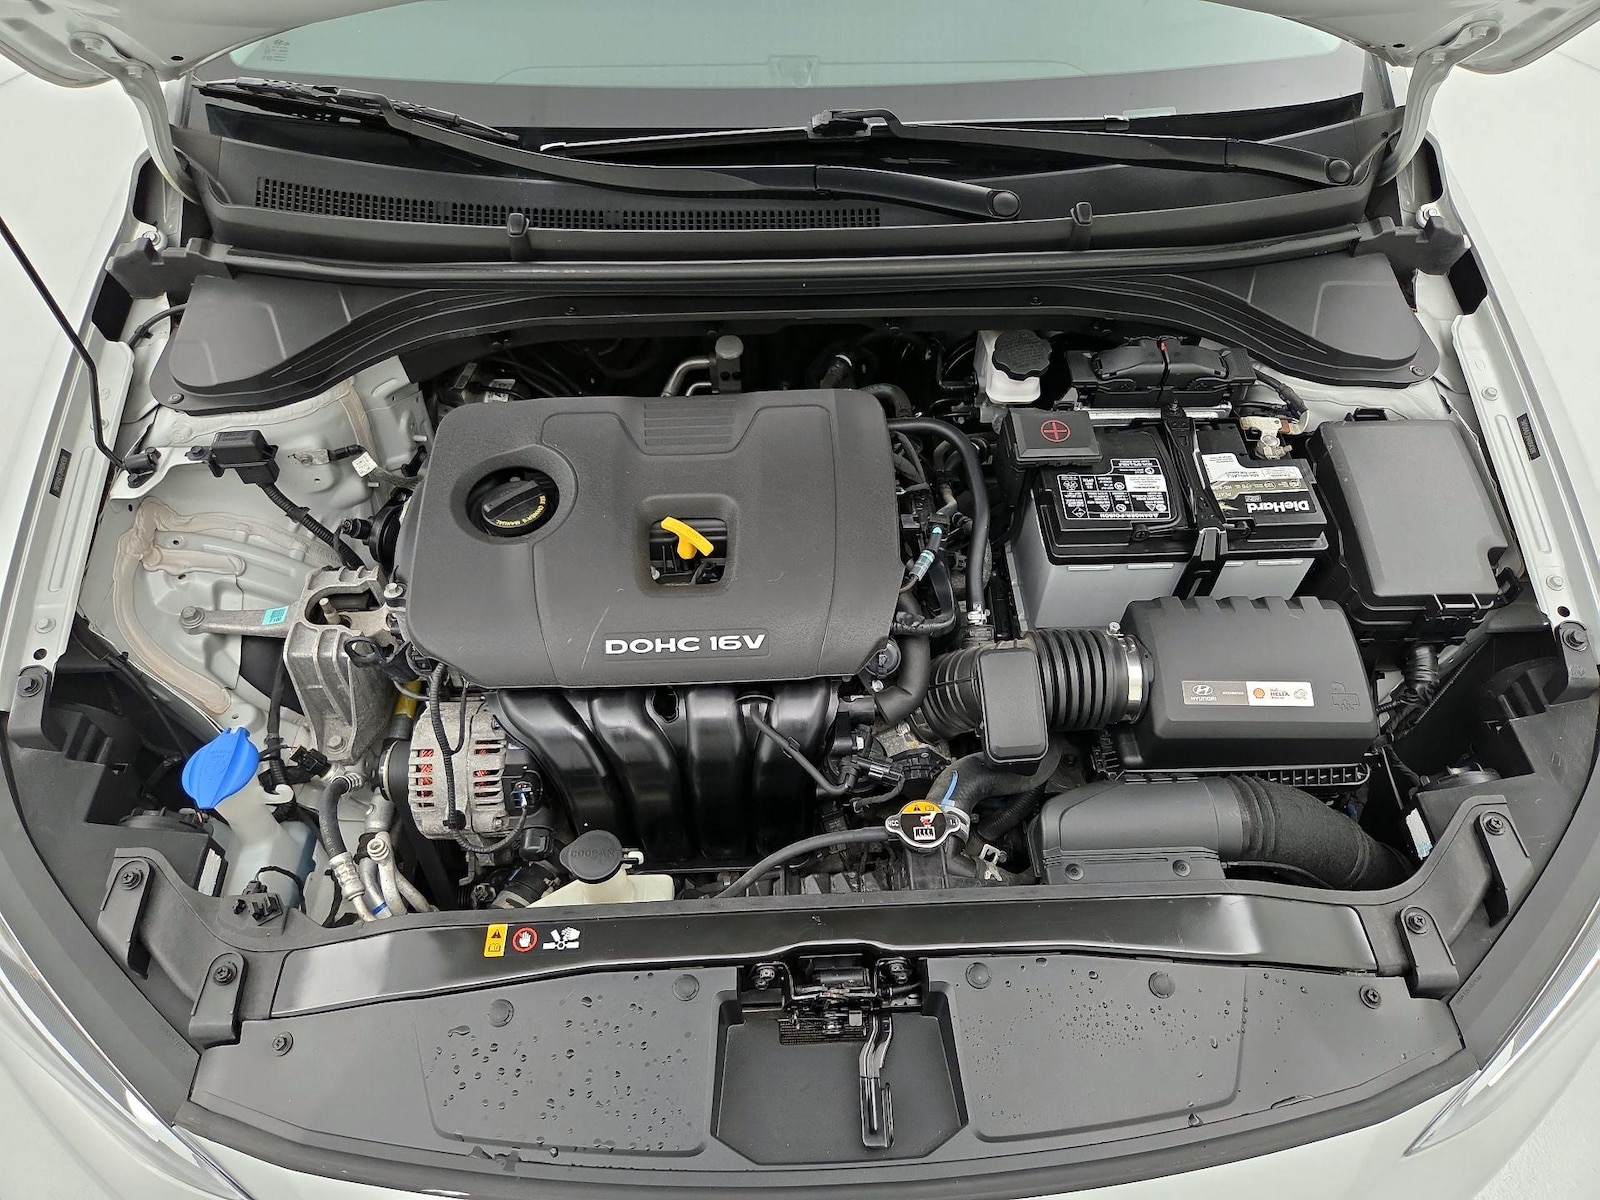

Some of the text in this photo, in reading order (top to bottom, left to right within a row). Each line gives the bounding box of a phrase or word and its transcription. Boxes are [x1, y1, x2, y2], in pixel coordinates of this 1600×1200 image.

[522, 505, 544, 523] OWNER'S
[1247, 501, 1310, 514] DieHard
[496, 519, 521, 527] MANUAL
[605, 634, 766, 655] DOHC 16V
